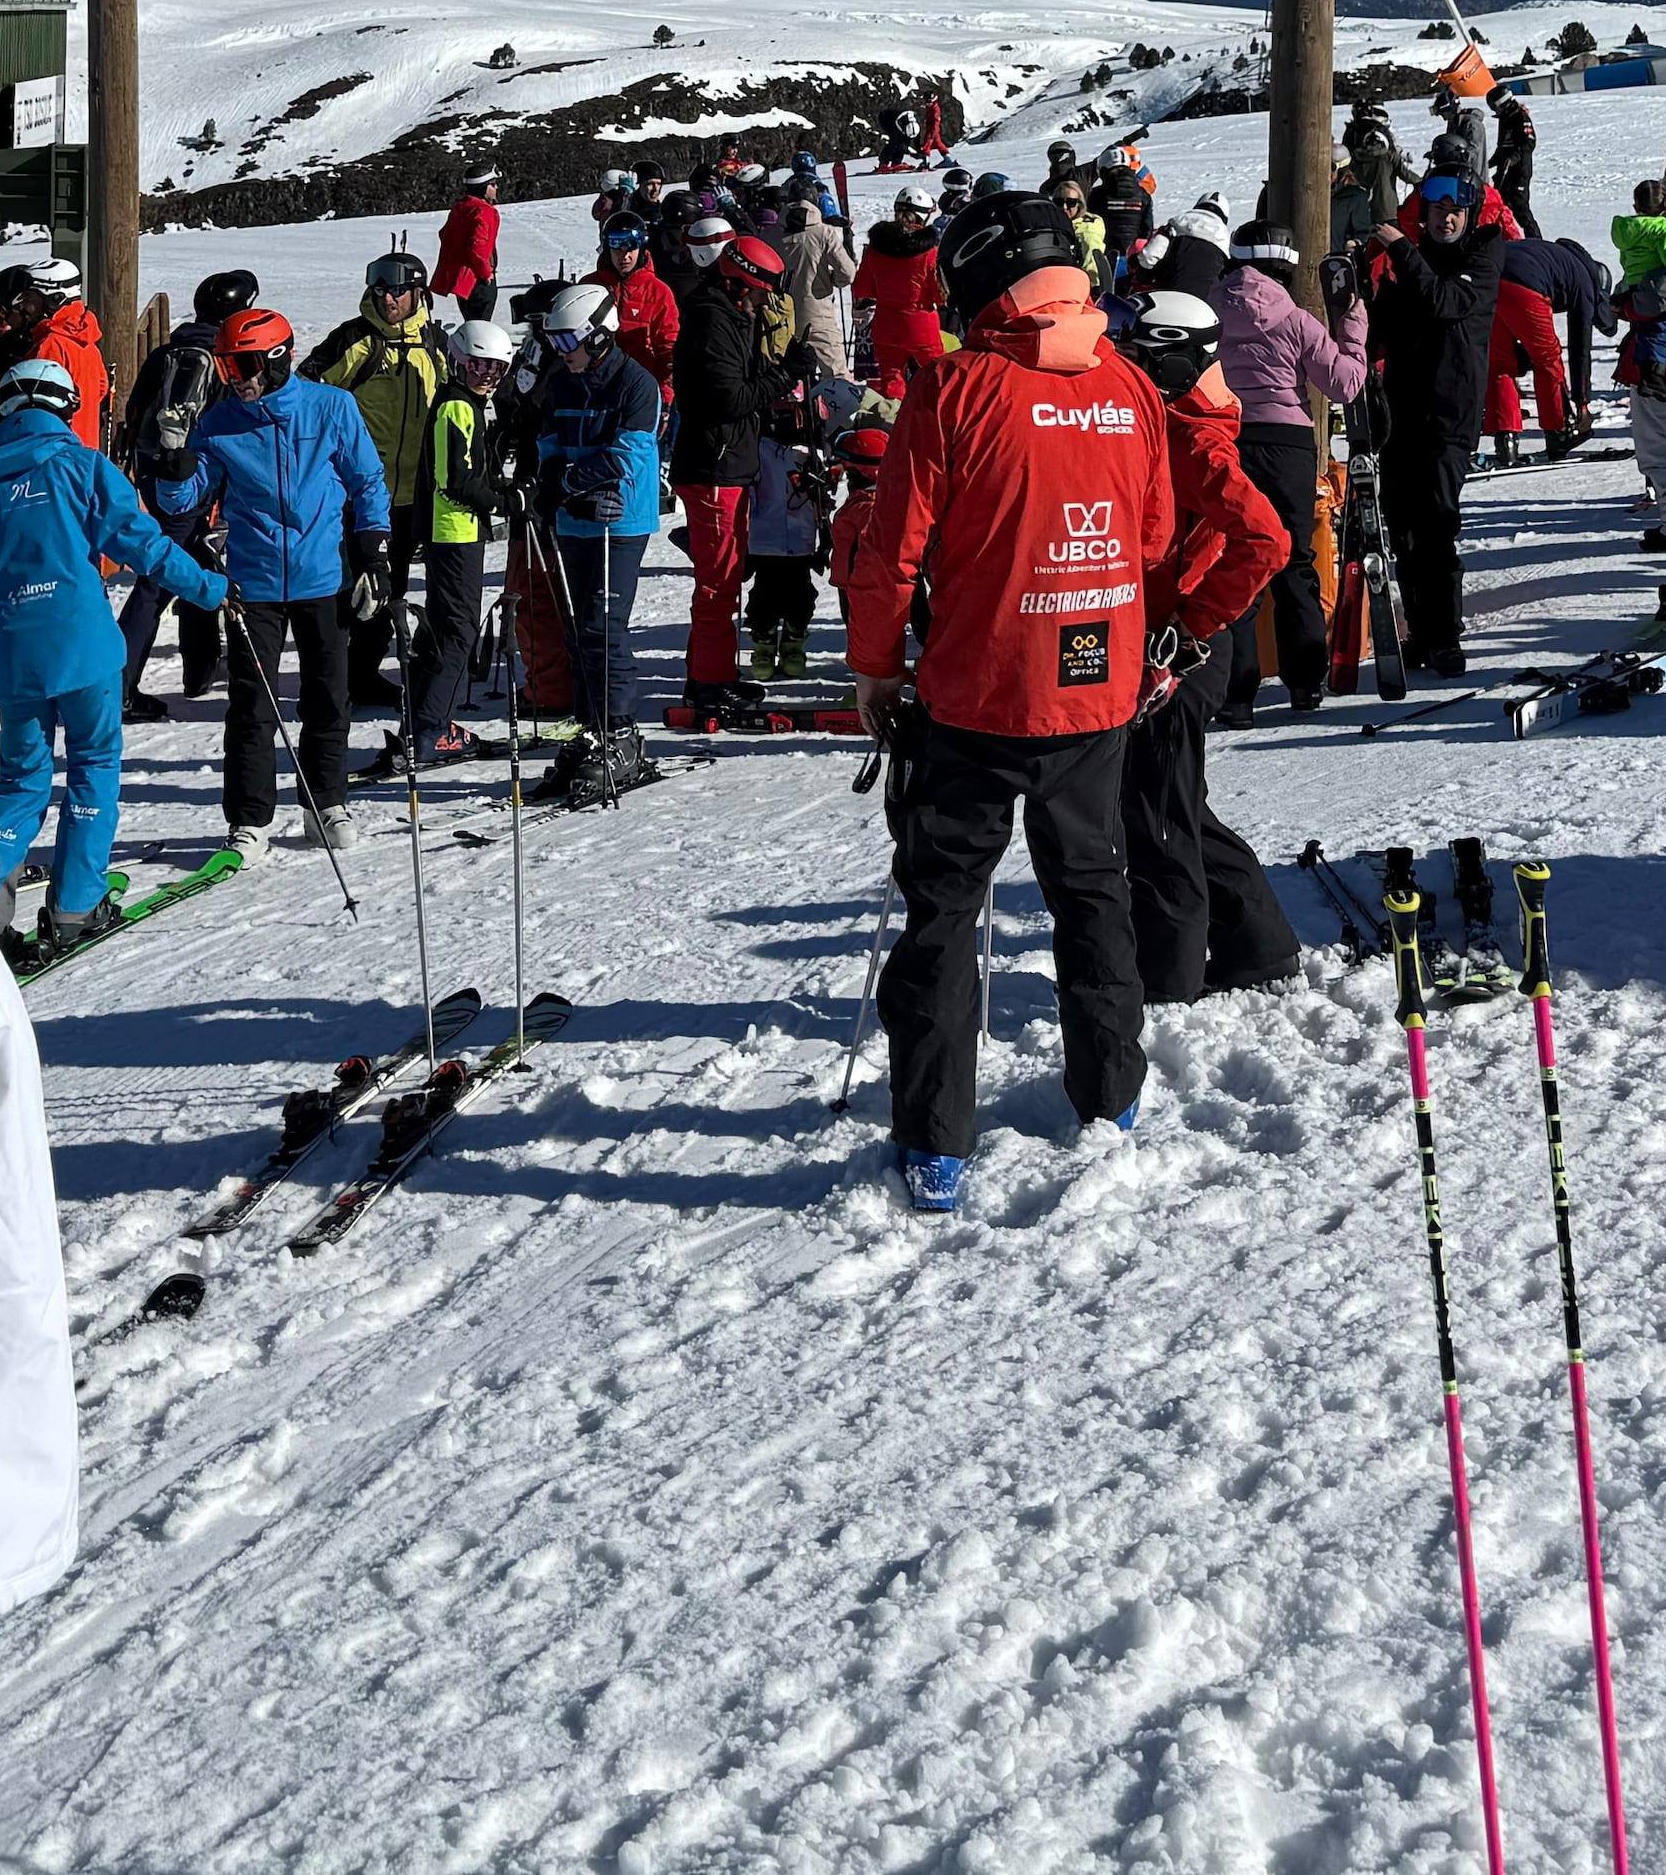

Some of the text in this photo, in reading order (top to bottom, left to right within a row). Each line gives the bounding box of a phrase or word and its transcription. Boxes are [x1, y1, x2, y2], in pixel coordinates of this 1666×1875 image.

[1032, 400, 1135, 432] Cuylás
[1049, 539, 1121, 562] UBCO
[17, 581, 58, 598] Almar
[1020, 588, 1087, 614] ELECTRIC
[1546, 1114, 1570, 1207] LEKI
[1418, 1146, 1443, 1240] LEKI
